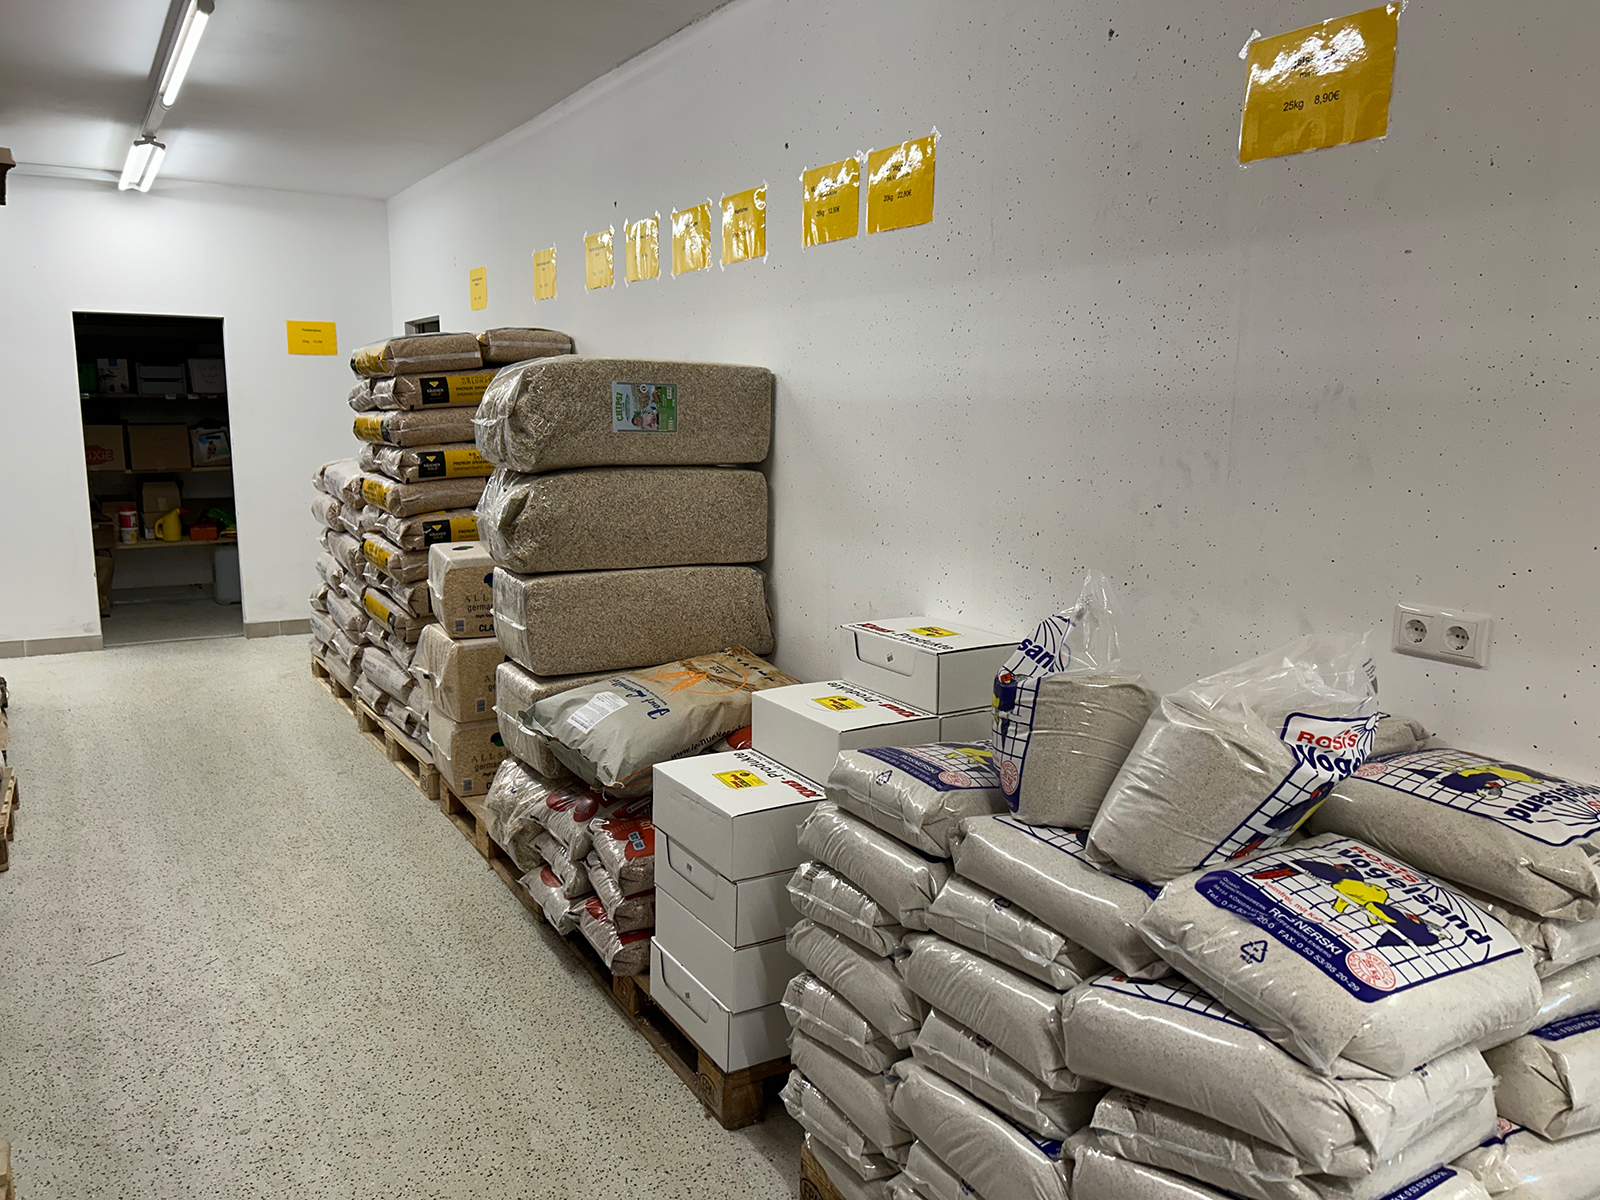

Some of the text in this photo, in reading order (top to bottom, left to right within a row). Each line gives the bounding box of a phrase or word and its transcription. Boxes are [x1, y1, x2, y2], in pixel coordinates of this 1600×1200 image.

[1283, 90, 1340, 112] 25kg 8,90€
[1017, 638, 1055, 671] san
[734, 752, 783, 779] Produkte
[1294, 903, 1308, 913] mit
[1337, 849, 1493, 945] Vogelsand
[1256, 915, 1275, 929] 20-0
[1277, 930, 1296, 945] FAX:
[1303, 947, 1315, 956] 53
[1313, 954, 1337, 973] 53/95
[1335, 971, 1360, 992] 20-29
